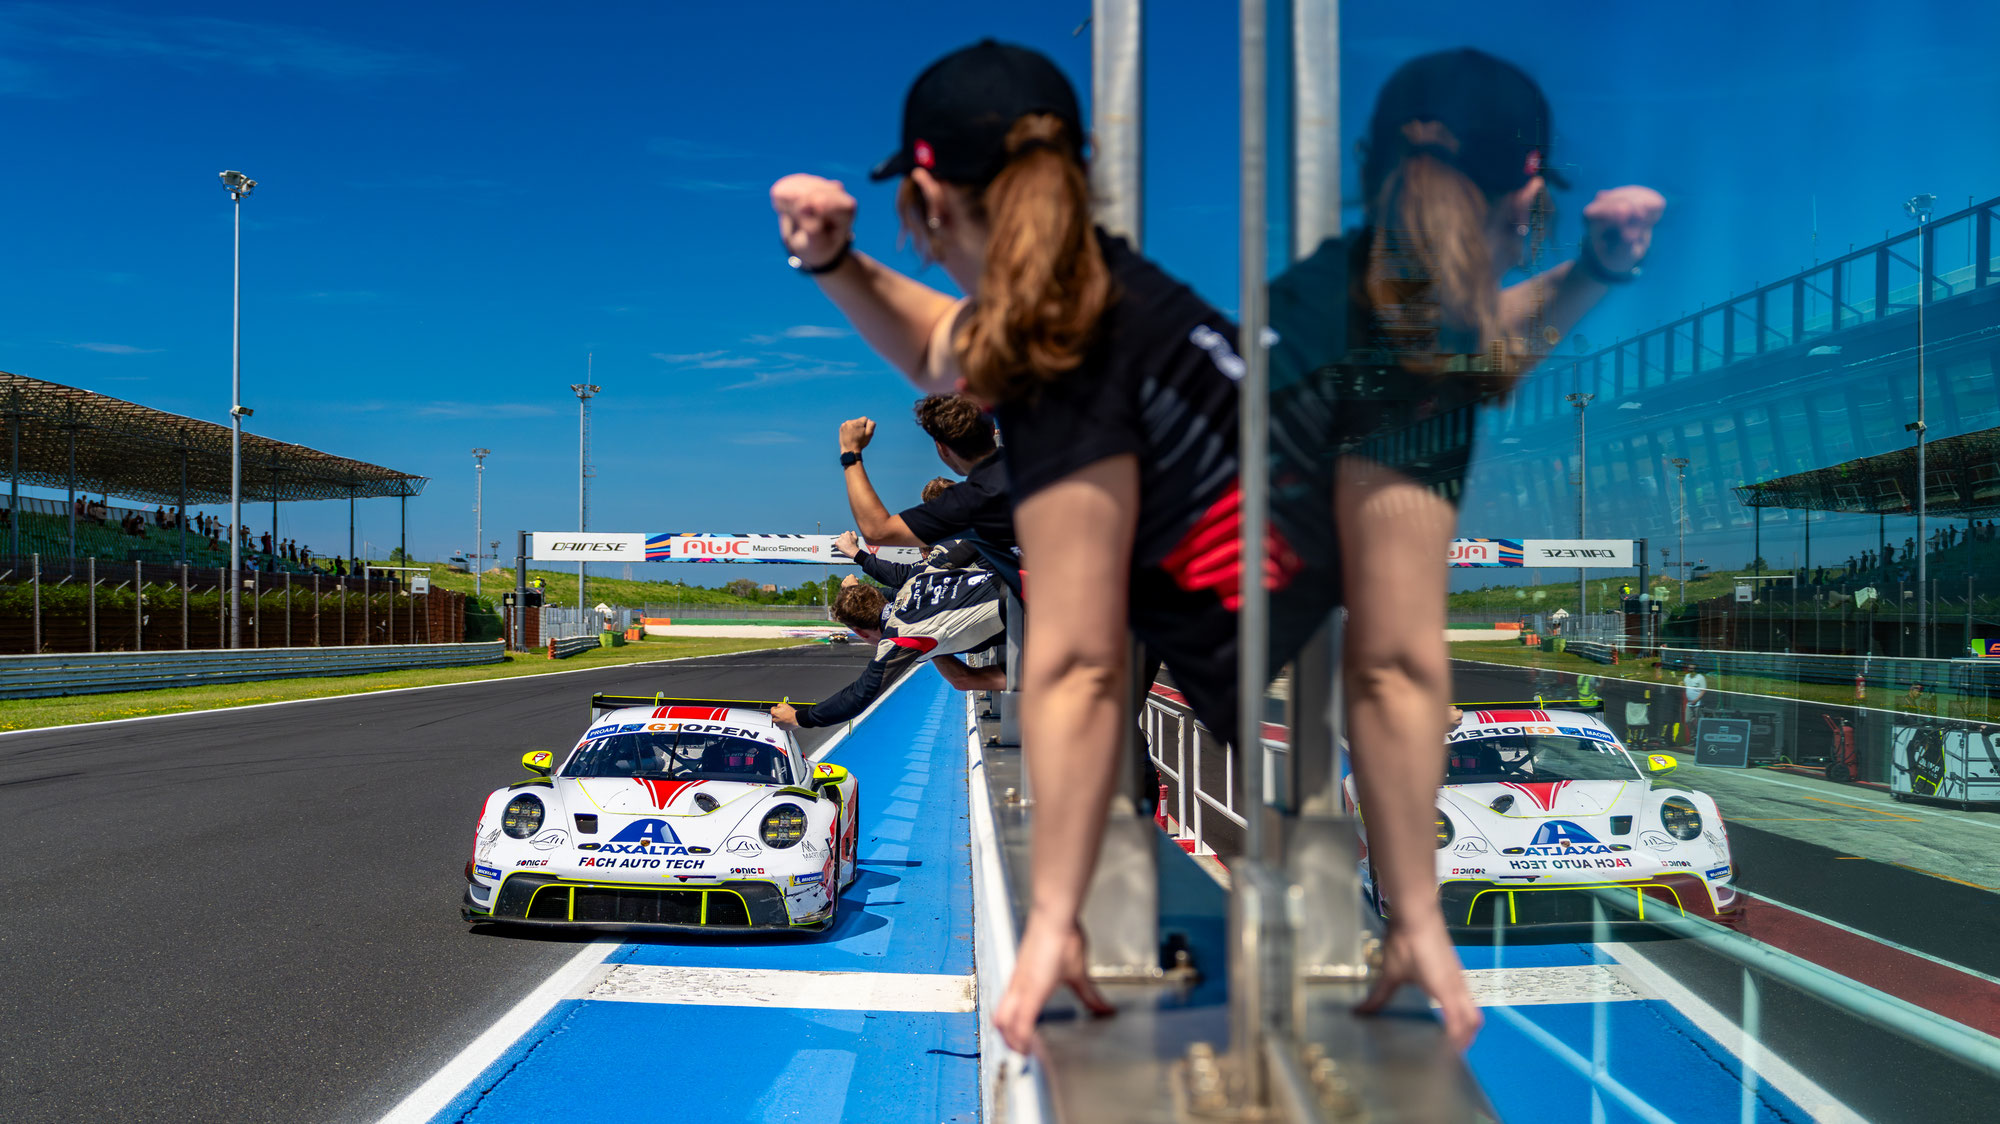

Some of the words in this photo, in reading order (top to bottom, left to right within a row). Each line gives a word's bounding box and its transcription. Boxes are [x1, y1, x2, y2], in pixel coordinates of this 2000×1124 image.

[551, 542, 628, 552] DAINESE
[752, 544, 778, 552] Marco
[778, 544, 819, 553] Simoncelli
[589, 726, 616, 737] PROAM
[585, 737, 610, 753] 11
[597, 844, 689, 855] AXALTA
[578, 857, 617, 868] FACH
[618, 858, 661, 868] AUTO
[666, 859, 705, 869] TECH
